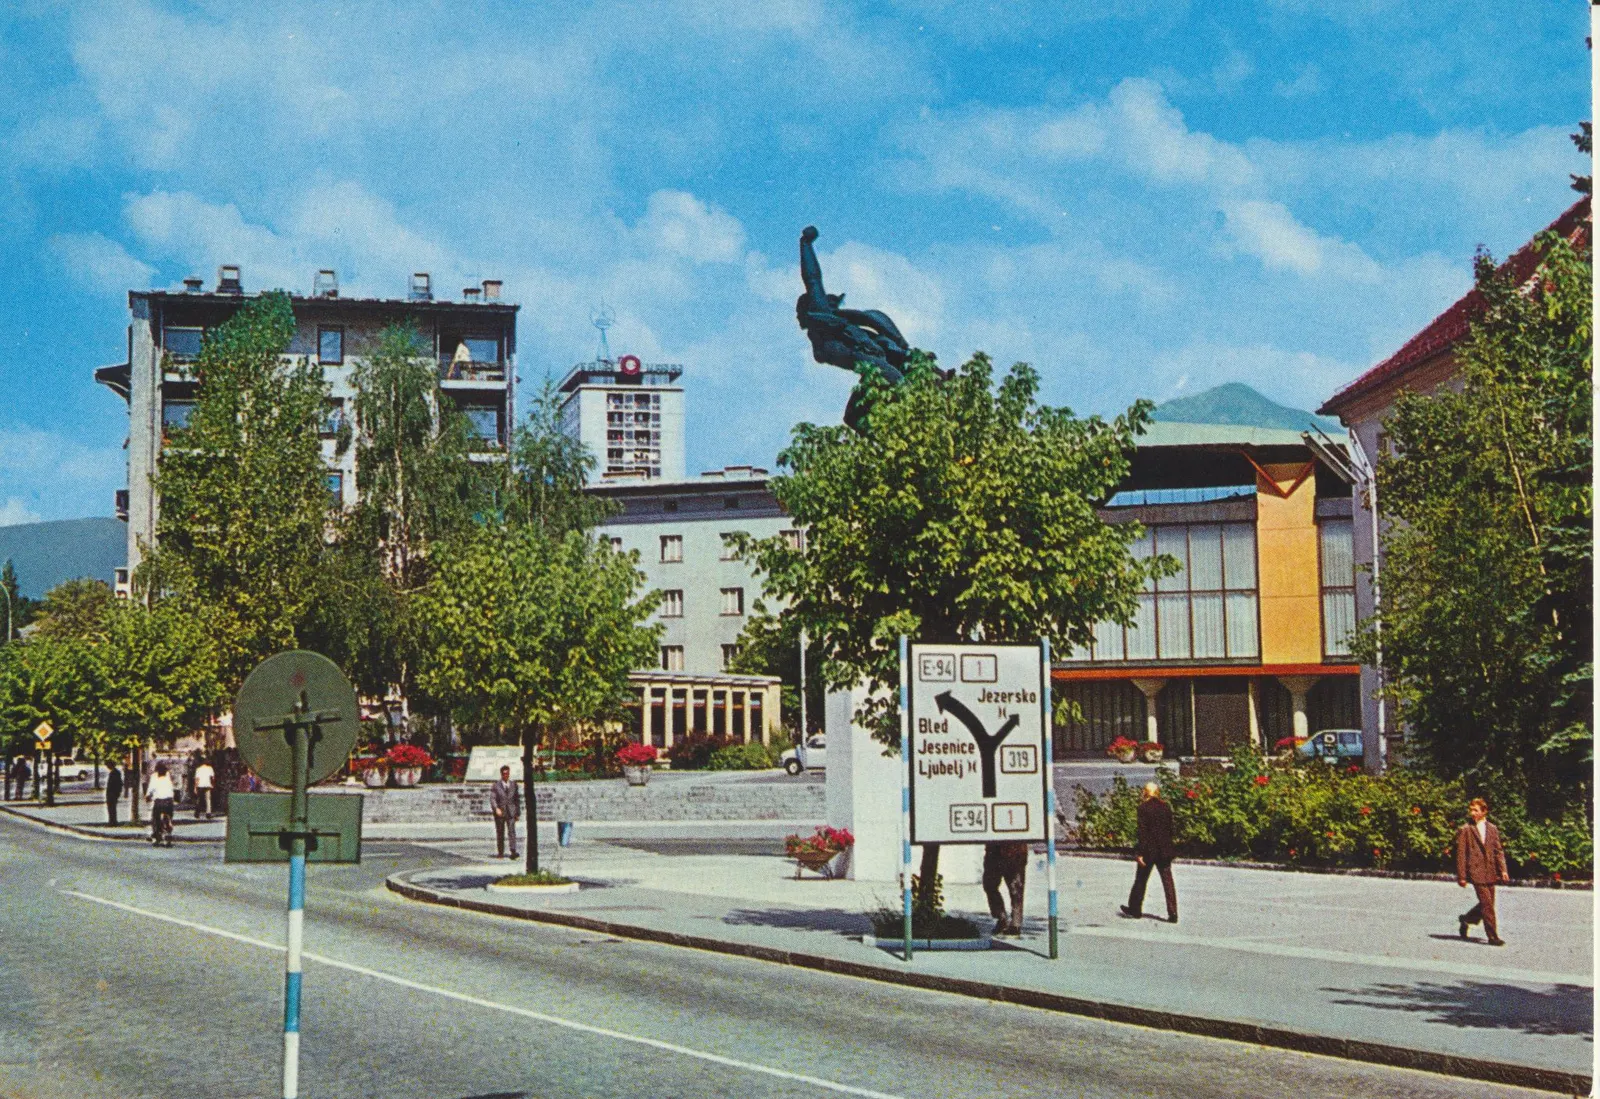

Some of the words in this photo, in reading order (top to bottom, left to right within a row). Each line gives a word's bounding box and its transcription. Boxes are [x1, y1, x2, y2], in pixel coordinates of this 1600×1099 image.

[923, 659, 952, 676] E-94
[977, 688, 1036, 704] Jezersko
[918, 718, 948, 734] Bled
[918, 739, 975, 755] Jesenice
[1009, 750, 1029, 768] 319
[918, 760, 963, 779] Ljubelj
[953, 810, 983, 828] E-94
